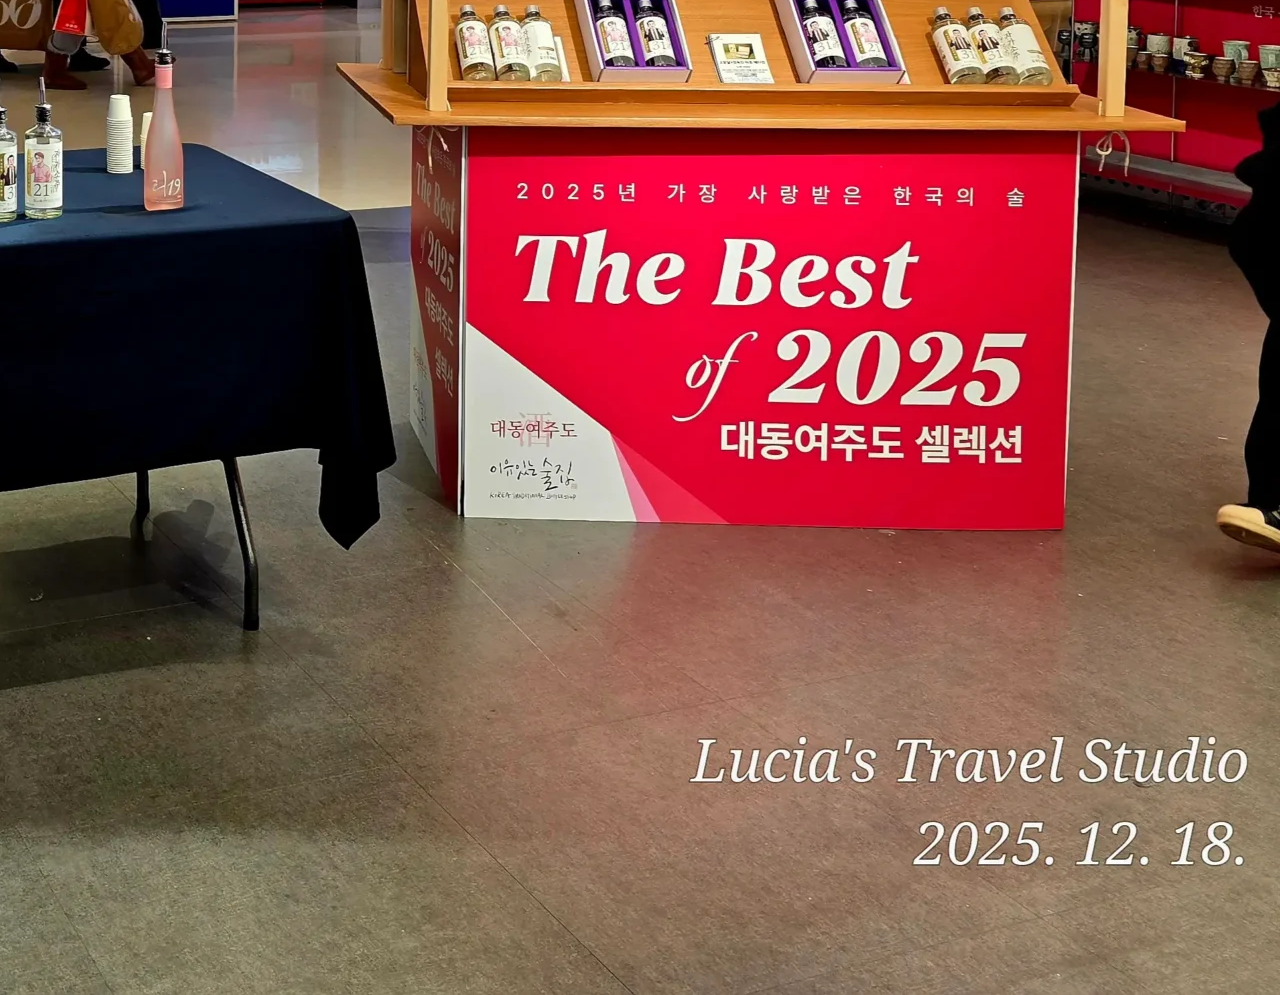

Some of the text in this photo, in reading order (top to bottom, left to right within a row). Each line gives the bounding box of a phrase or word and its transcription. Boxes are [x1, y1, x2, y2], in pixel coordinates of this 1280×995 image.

[1251, 5, 1275, 19] 한국
[33, 183, 50, 197] 21
[516, 182, 1026, 208] 2025년 가장 사랑받은 한국의 술
[427, 229, 455, 293] 2025
[515, 228, 920, 310] The Best
[671, 329, 1027, 423] of 2025
[490, 419, 578, 440] 대동여주도
[720, 420, 1023, 465] 대동여주도 셀렉션
